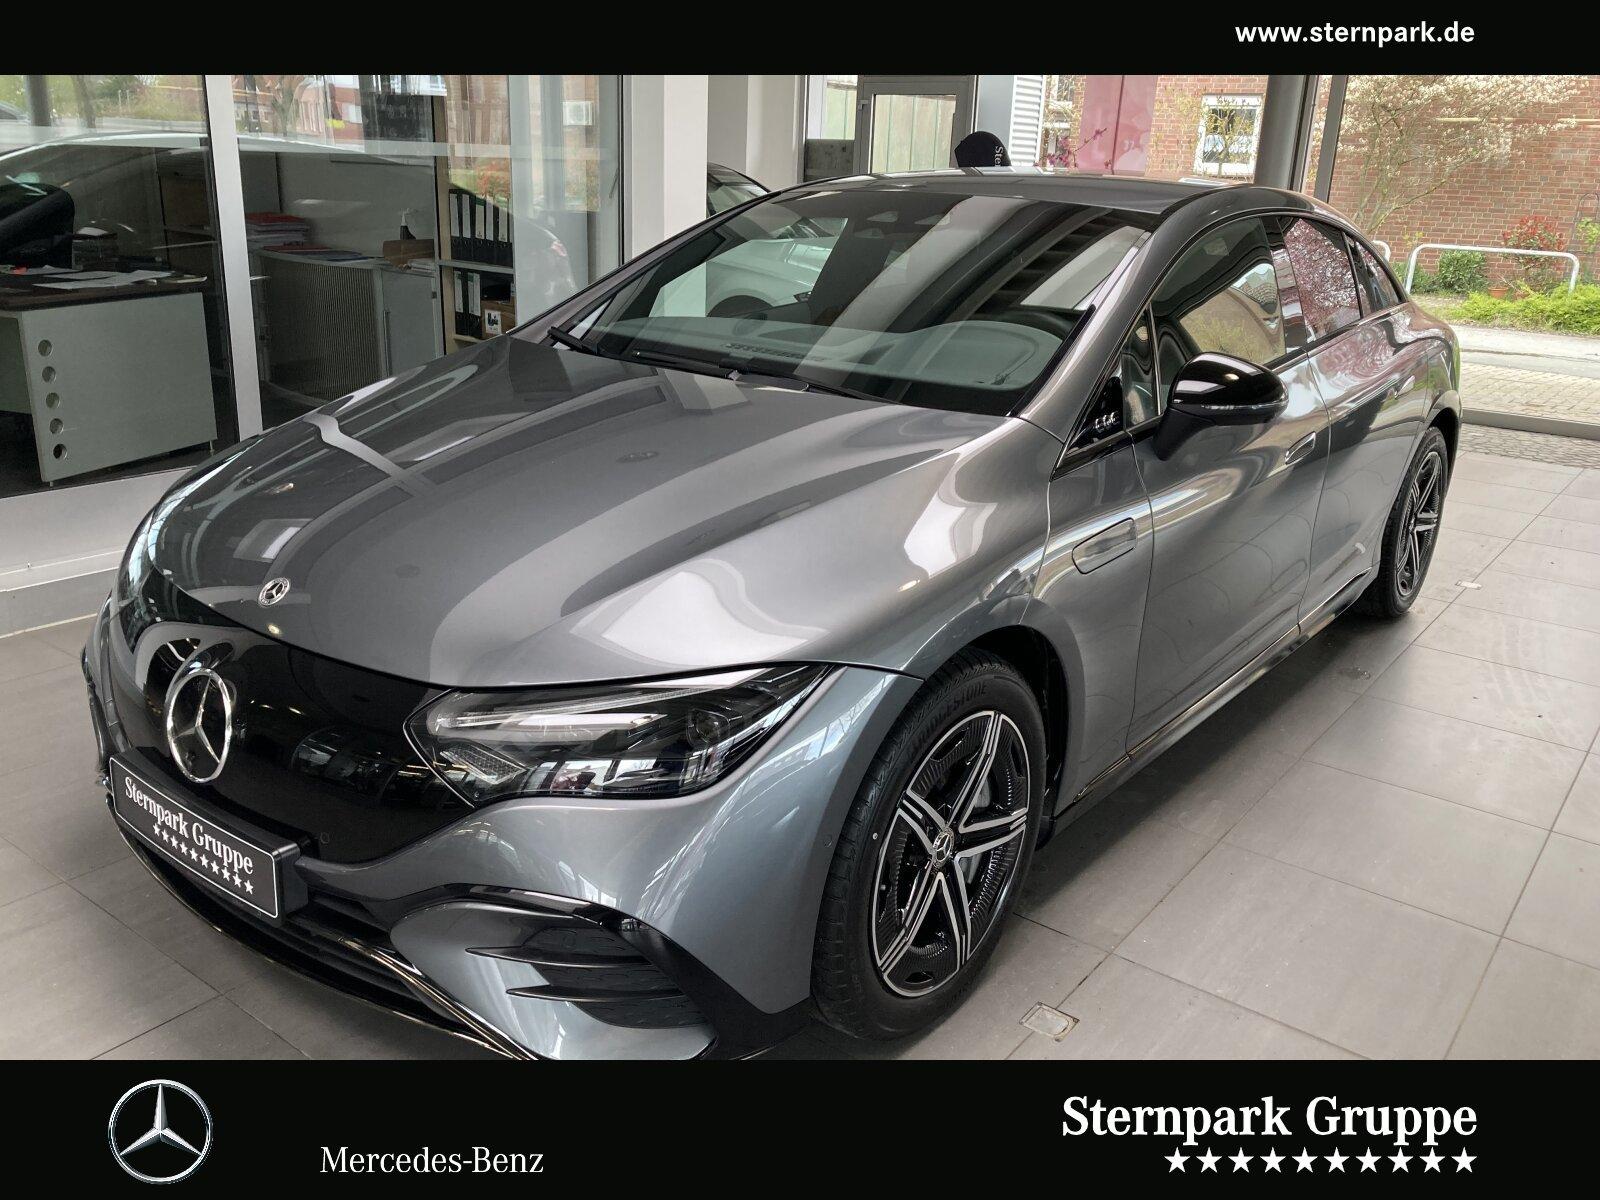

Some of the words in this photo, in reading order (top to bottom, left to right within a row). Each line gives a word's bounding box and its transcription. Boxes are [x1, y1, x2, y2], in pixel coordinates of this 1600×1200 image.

[994, 145, 1004, 167] Ste
[125, 776, 189, 839] Sternpark
[192, 822, 254, 875] Gruppe
